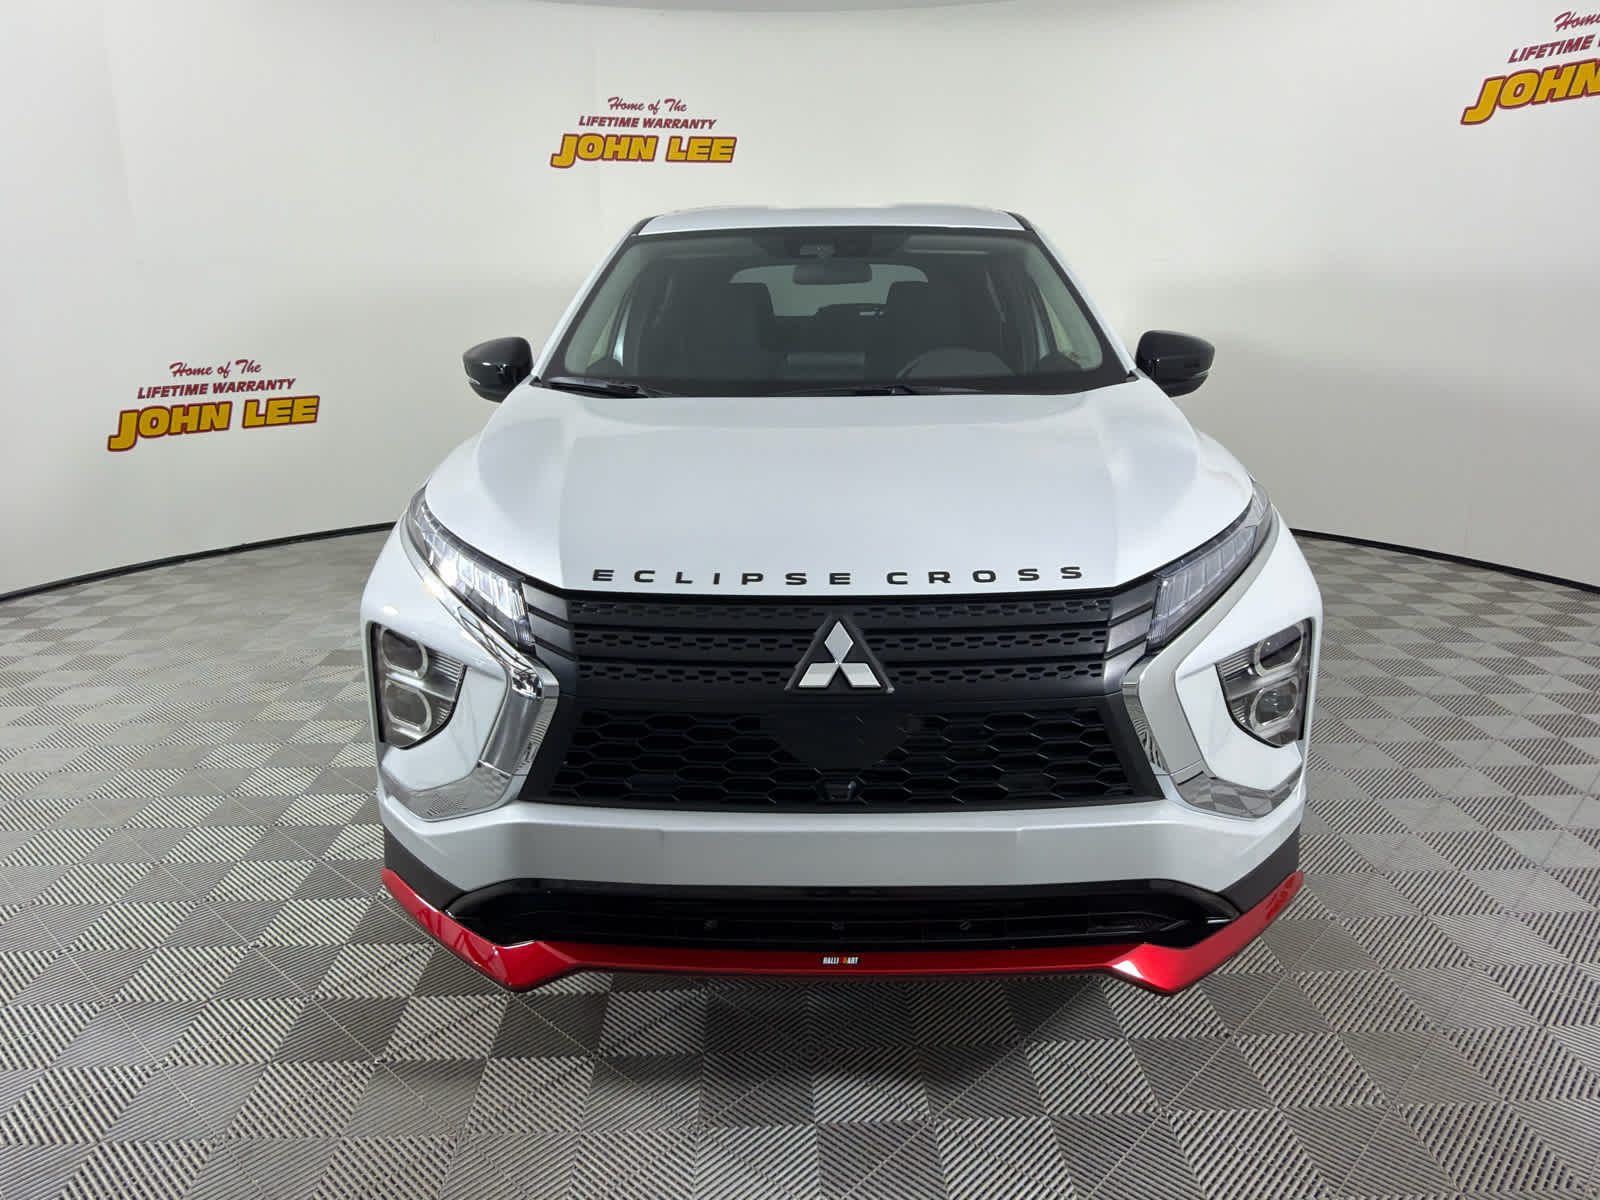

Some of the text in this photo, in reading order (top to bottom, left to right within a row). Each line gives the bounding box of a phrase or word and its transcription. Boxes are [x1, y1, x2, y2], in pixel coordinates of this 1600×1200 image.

[1507, 34, 1596, 64] LIFETIME
[607, 96, 688, 116] Home of The
[578, 115, 717, 130] LIFETIME WARRANTY
[550, 133, 737, 169] JOHN LEE
[169, 359, 263, 378] Home of The
[137, 377, 297, 400] LIFETIME WARRANTY
[107, 395, 321, 453] JOHN LEE
[592, 565, 1084, 586] ECLIPSE CROSS
